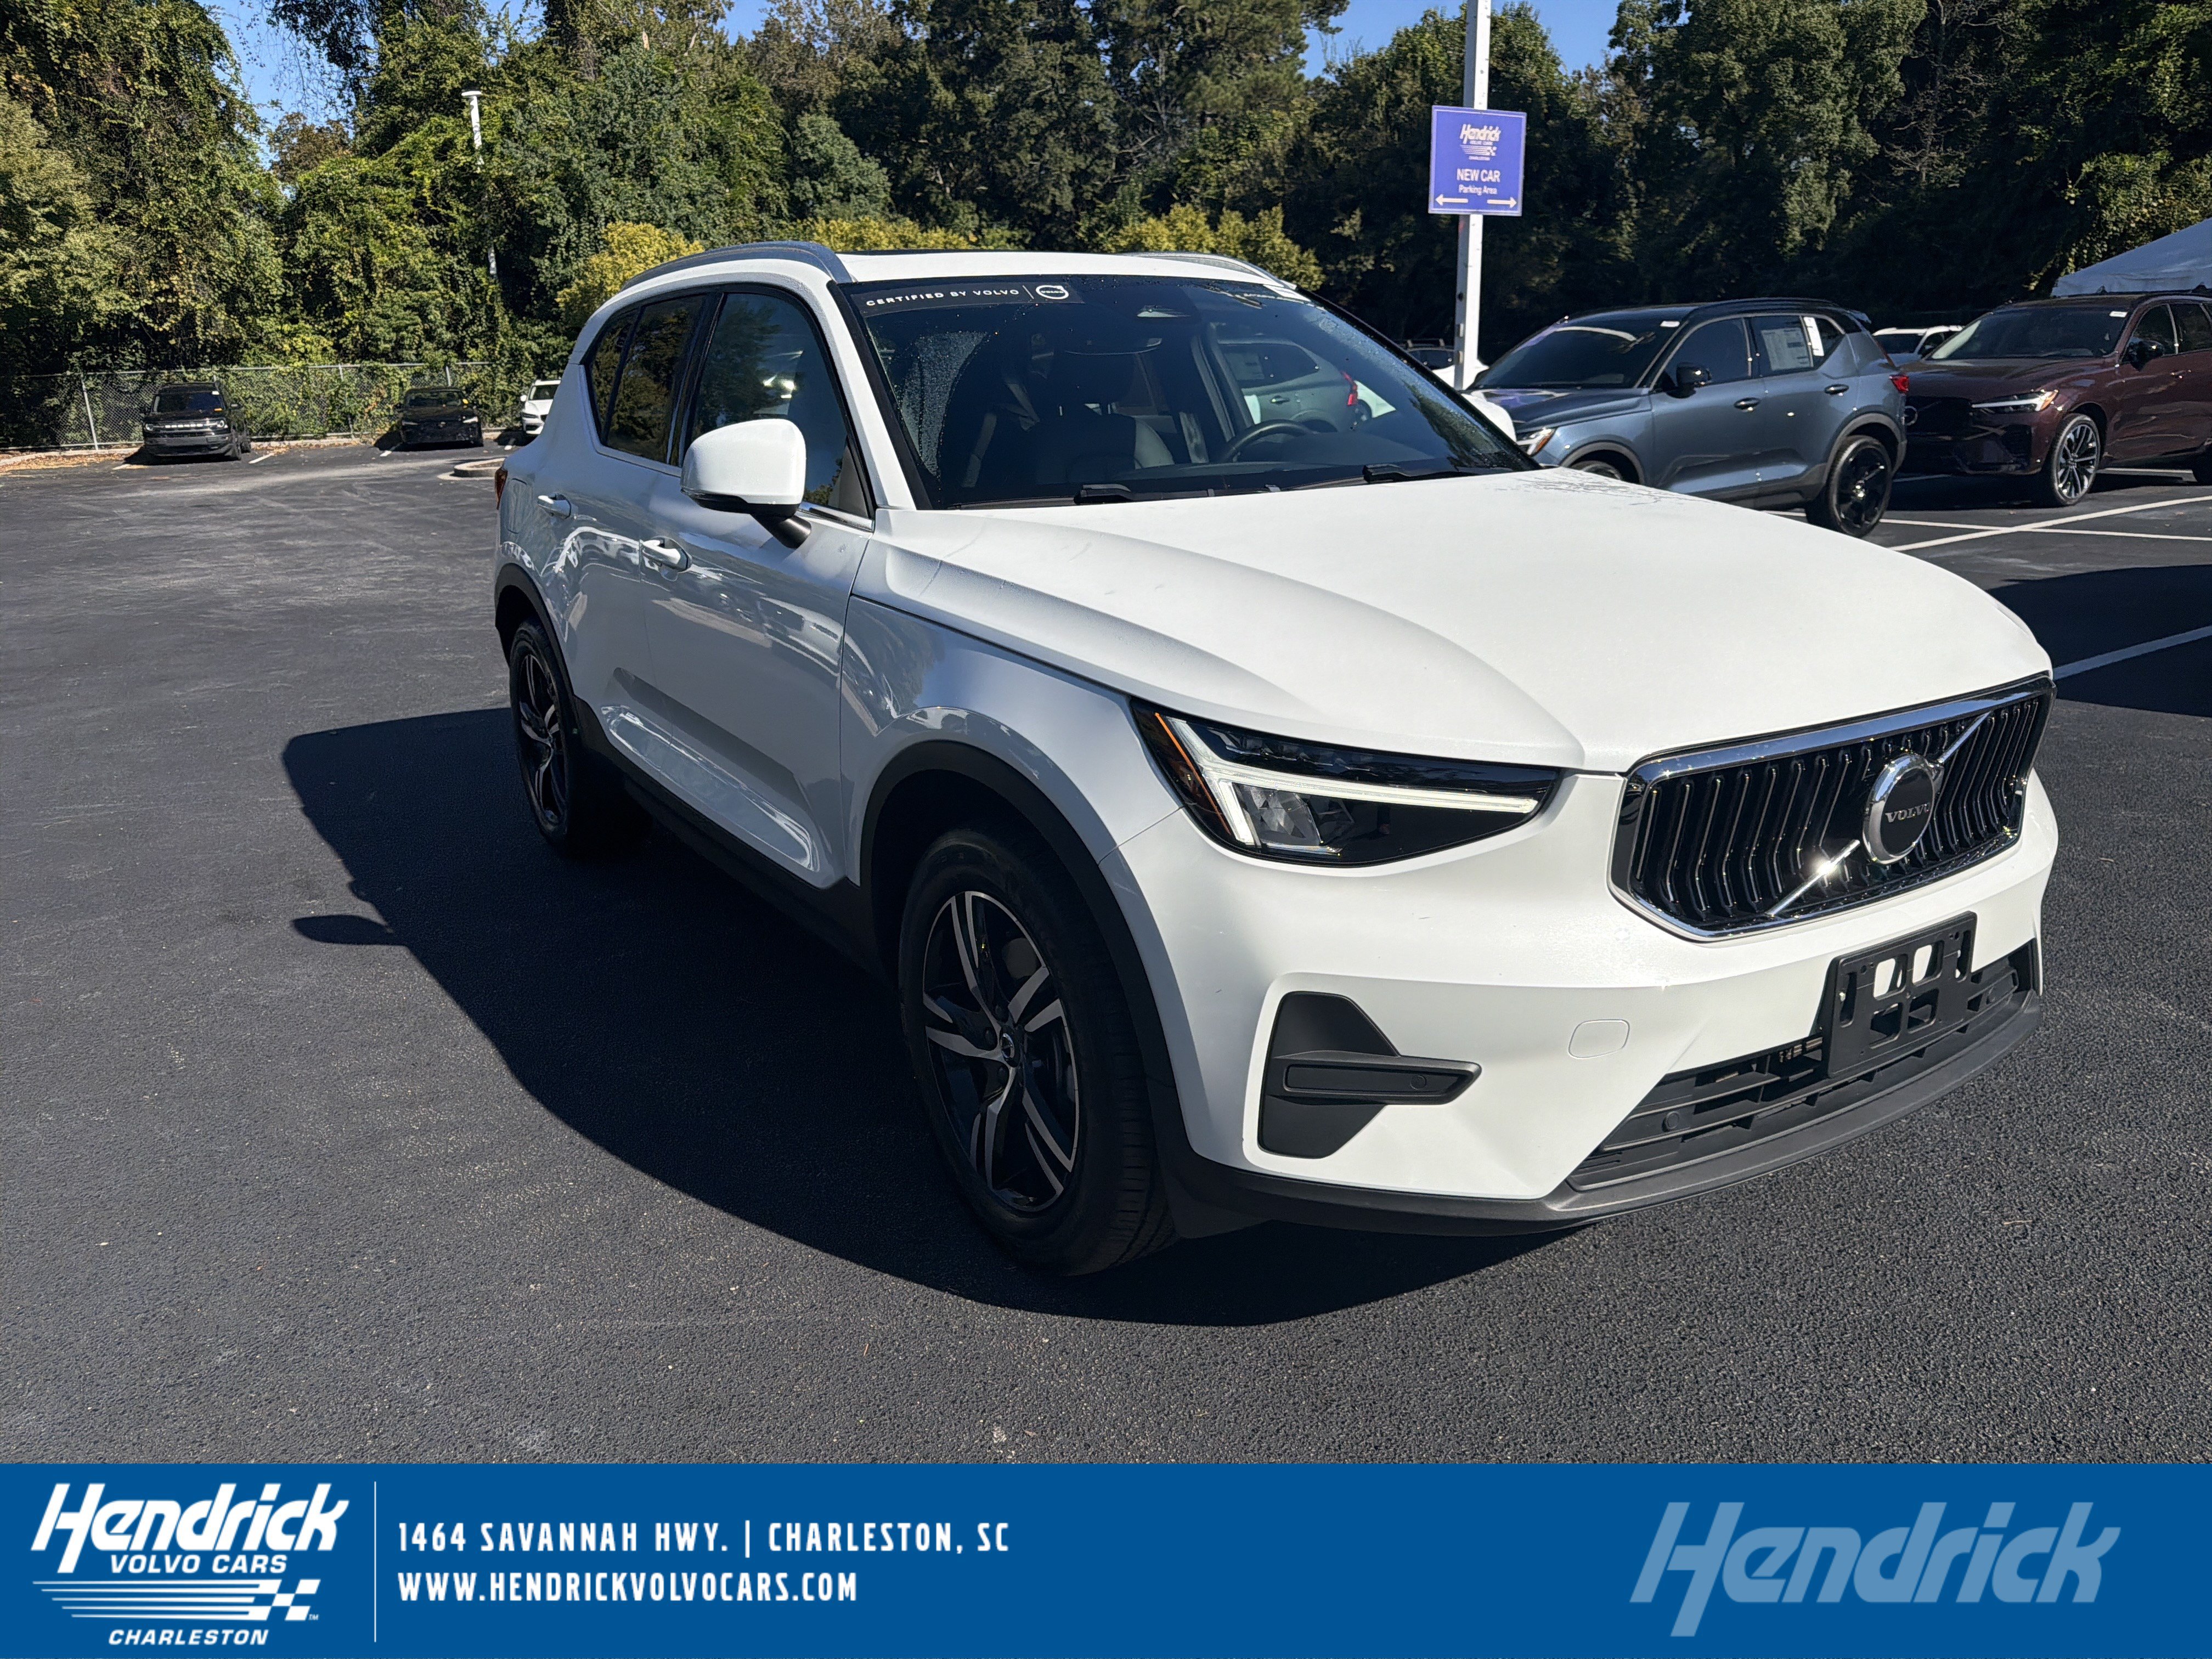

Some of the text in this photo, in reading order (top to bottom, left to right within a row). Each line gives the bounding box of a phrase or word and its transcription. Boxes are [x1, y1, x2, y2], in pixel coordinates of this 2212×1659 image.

[1457, 168, 1500, 183] NEW CAR
[1458, 184, 1498, 196] Parking Area
[866, 292, 944, 307] CERTIFIED
